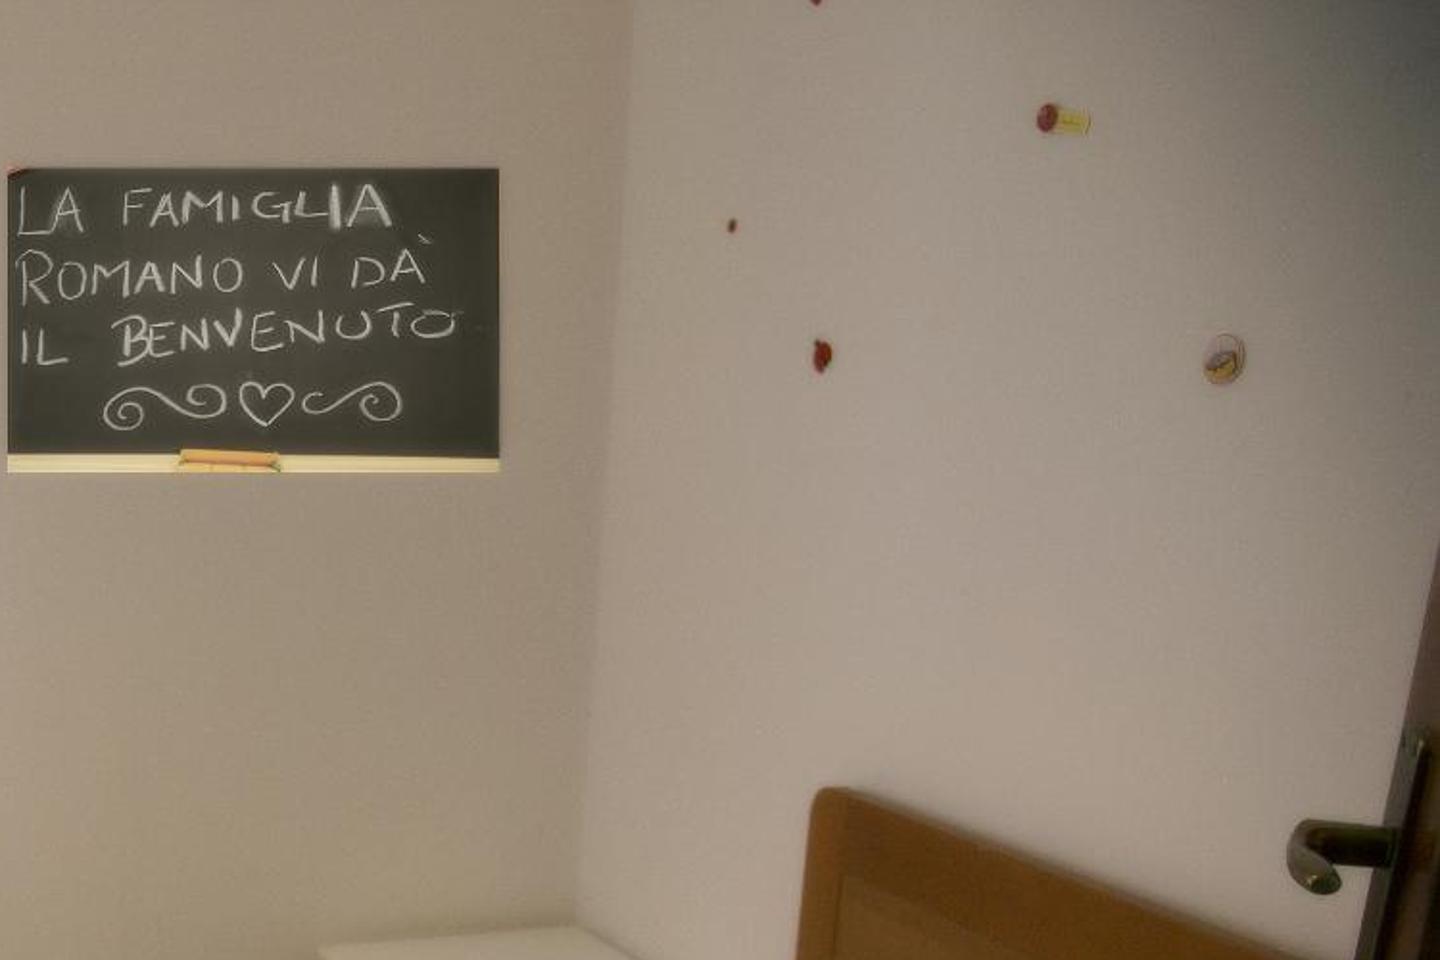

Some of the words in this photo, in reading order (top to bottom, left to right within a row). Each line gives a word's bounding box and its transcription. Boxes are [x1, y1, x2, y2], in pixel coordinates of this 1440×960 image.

[16, 185, 85, 236] LA
[122, 183, 393, 231] FAMIGLIA
[16, 248, 244, 306] ROMANO
[271, 256, 319, 291] VI
[350, 233, 433, 289] DÀ
[20, 328, 69, 366] IL
[110, 301, 456, 368] BENVENUTO
